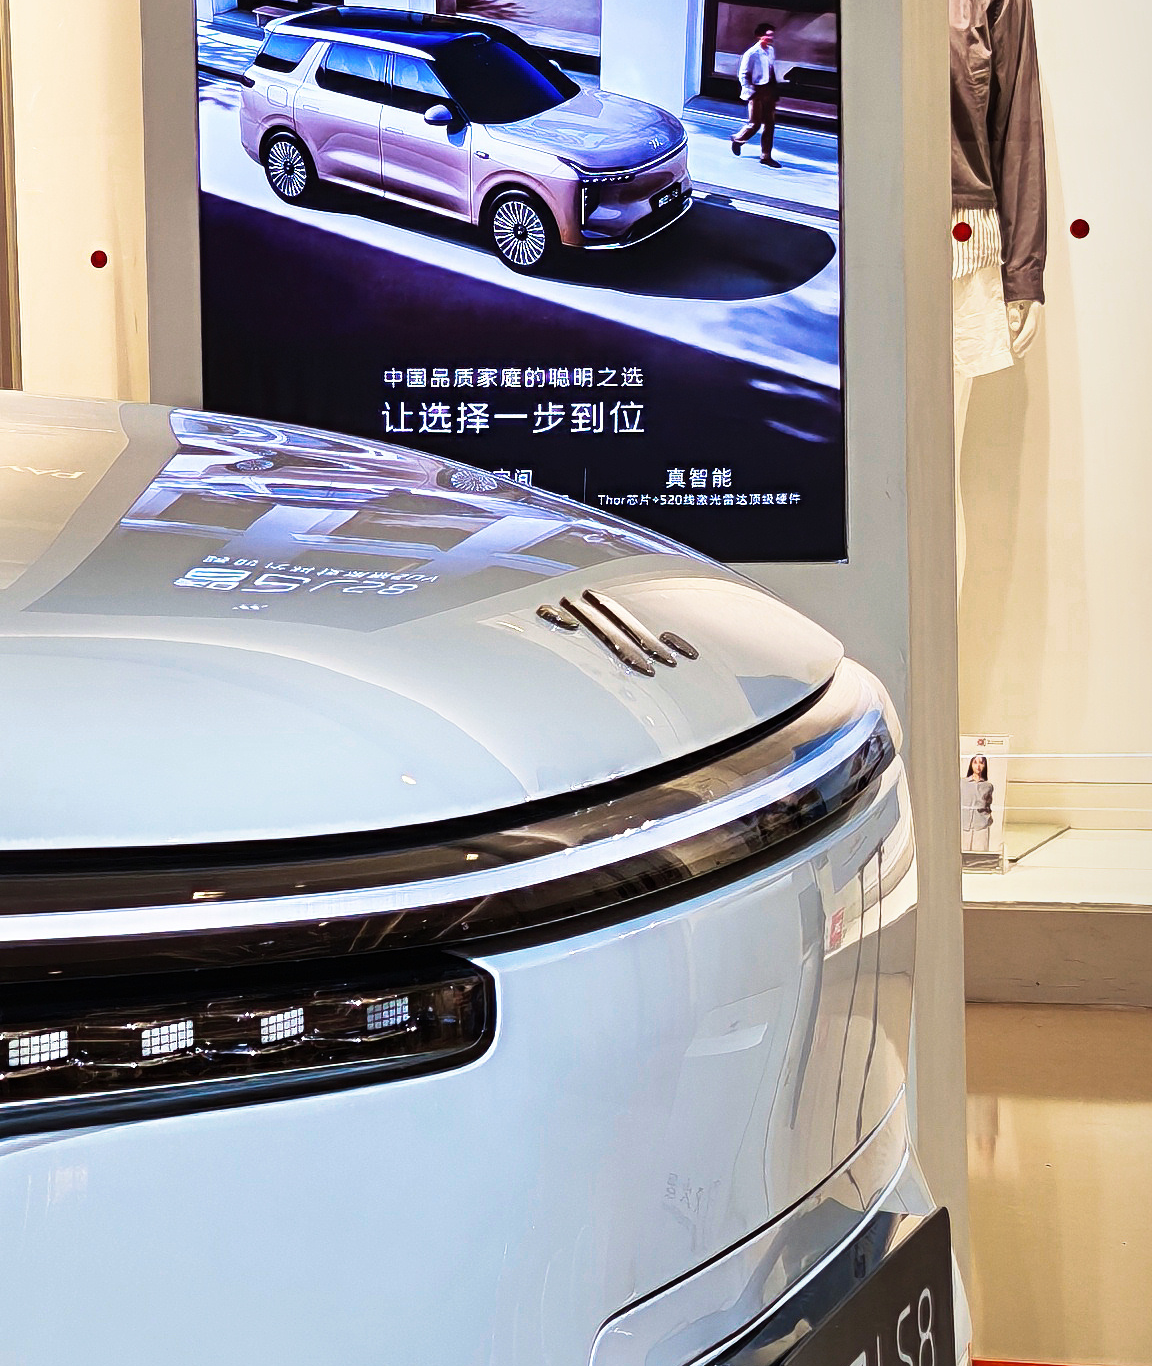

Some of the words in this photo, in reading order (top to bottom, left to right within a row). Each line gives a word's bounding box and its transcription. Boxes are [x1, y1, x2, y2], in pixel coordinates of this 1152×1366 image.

[383, 366, 645, 389] 中国品质家庭的聪明之选
[381, 401, 646, 435] 让选择一步到位
[665, 467, 733, 489] 真智能
